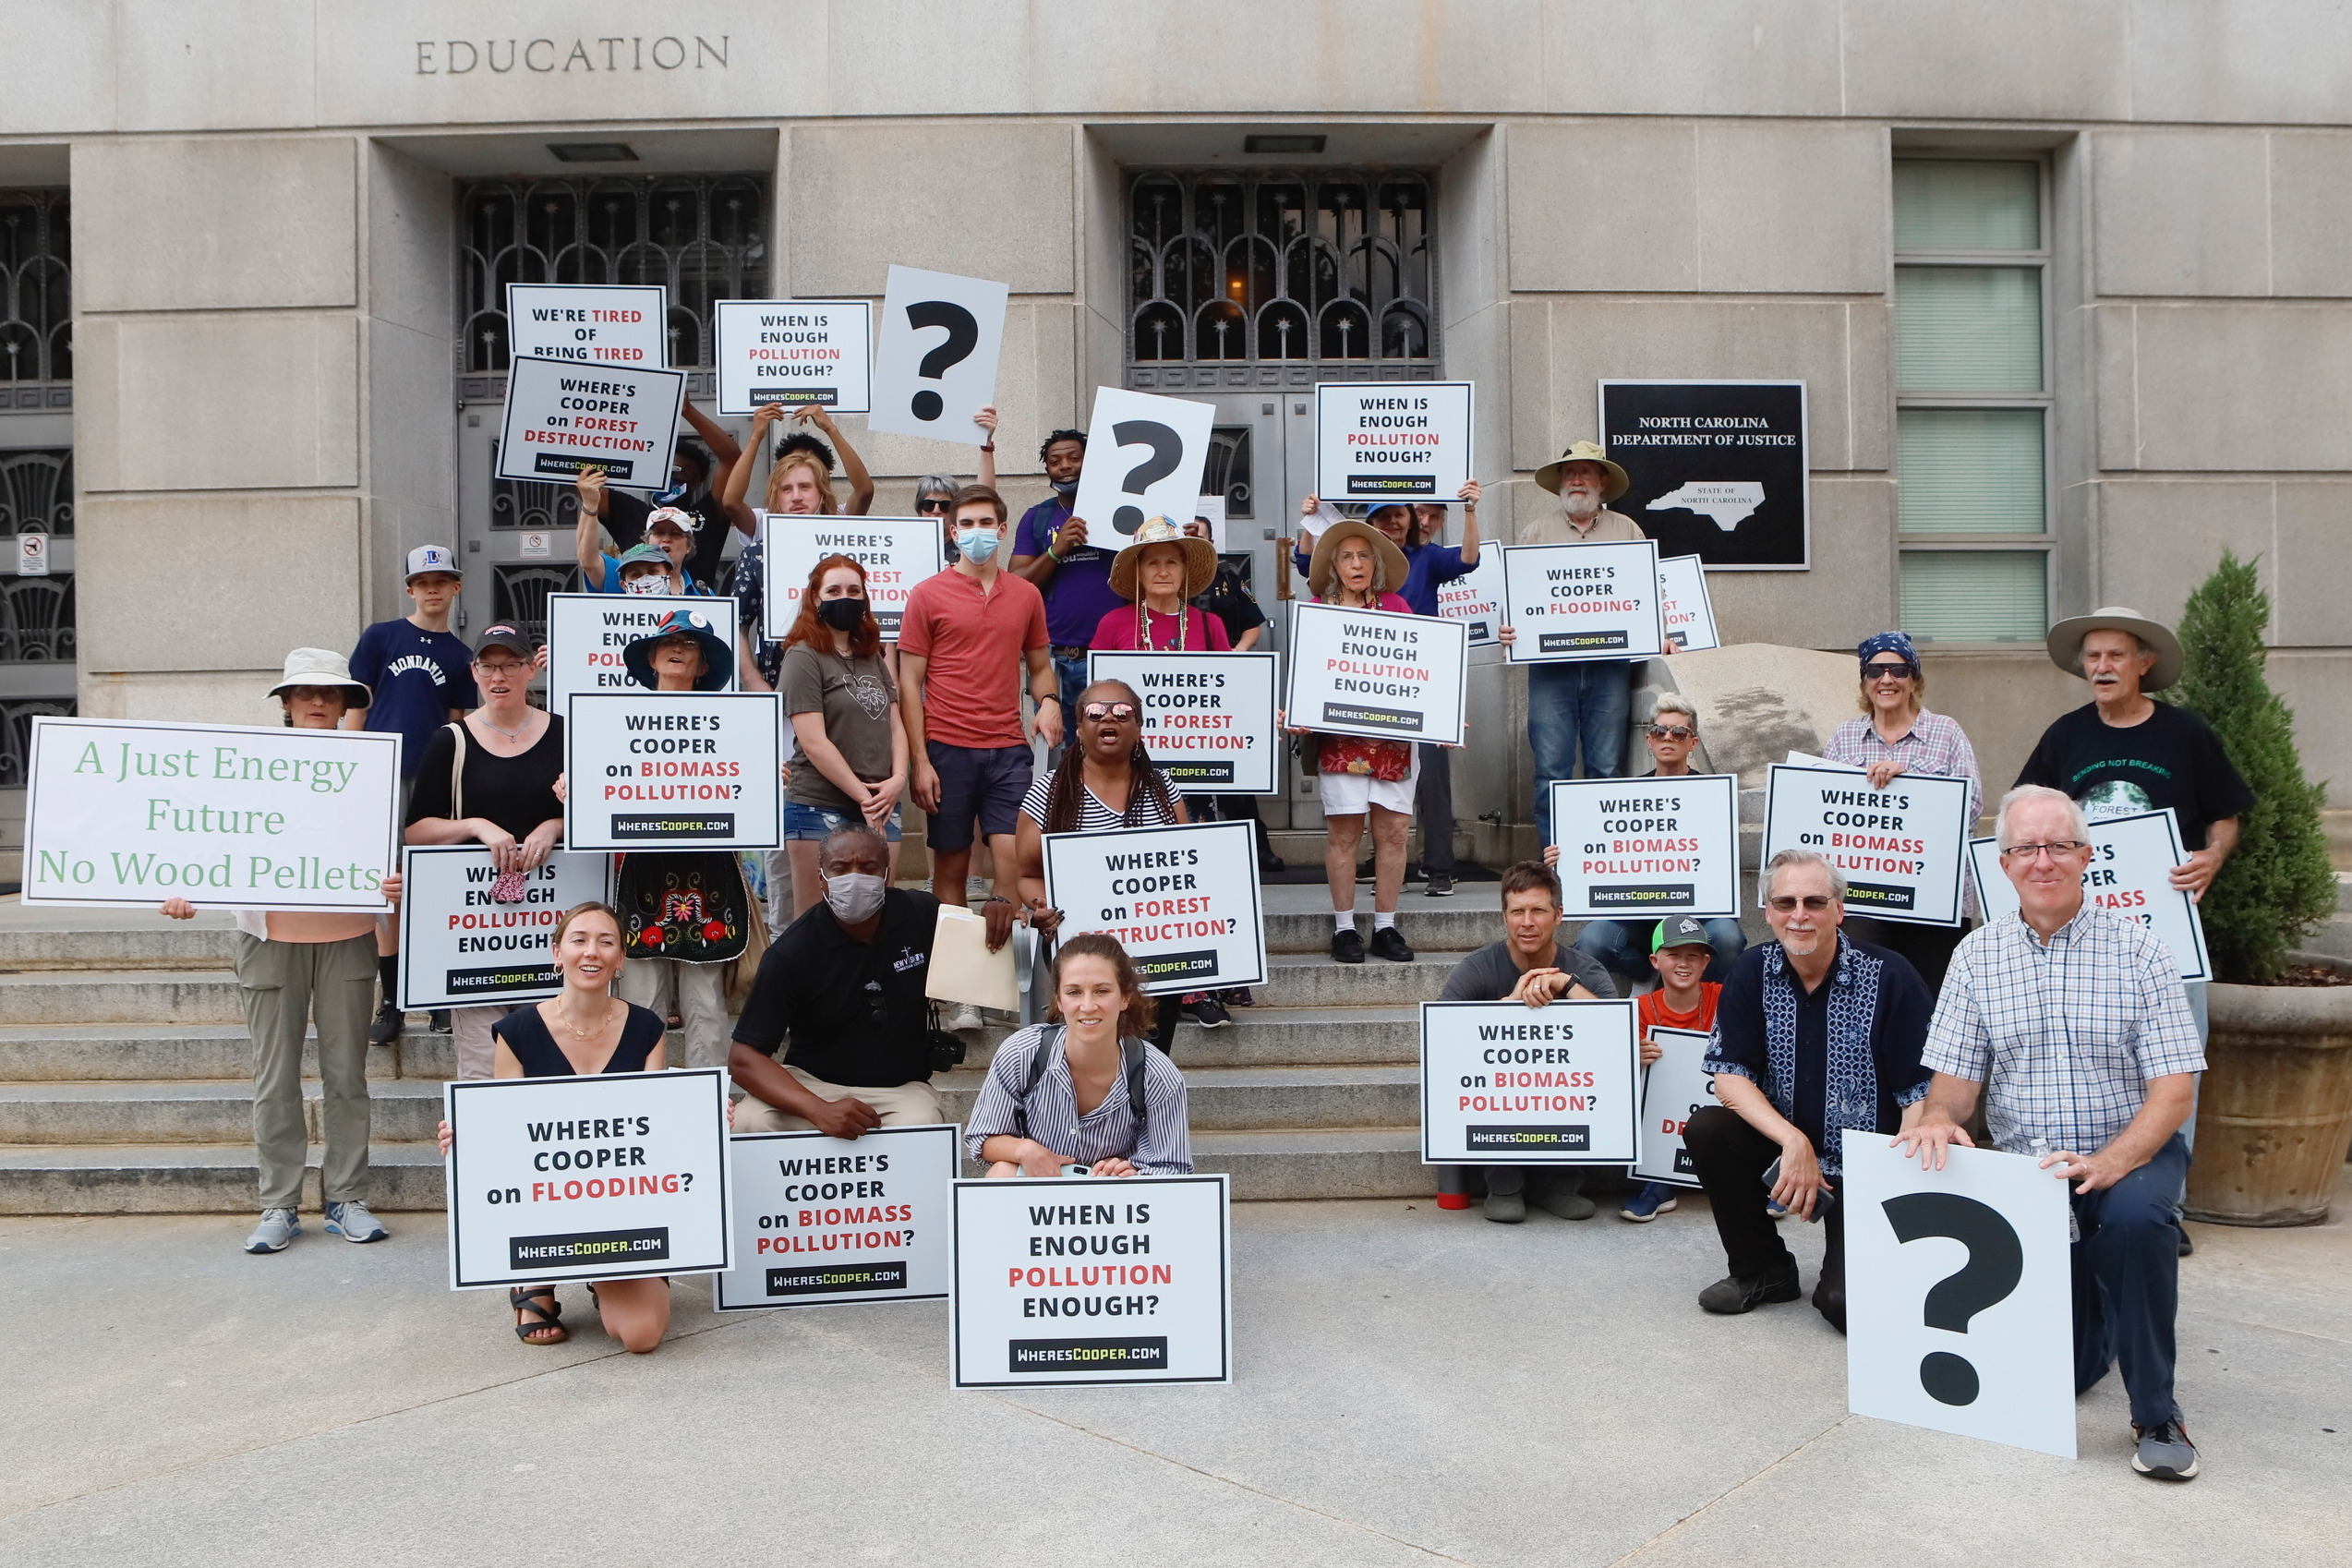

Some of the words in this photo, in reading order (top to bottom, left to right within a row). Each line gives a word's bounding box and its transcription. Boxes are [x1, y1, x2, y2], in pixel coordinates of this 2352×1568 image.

[416, 37, 730, 75] EDUCATION
[533, 309, 585, 321] WE'RE
[592, 310, 641, 322] TIRED
[761, 316, 808, 326] WHEN
[815, 316, 827, 326] IS
[575, 329, 596, 341] OF
[761, 332, 827, 343] ENOUGH
[594, 347, 643, 360] TIRED
[750, 349, 839, 359] POLLUTION
[905, 300, 979, 421] ?
[758, 366, 833, 376] ENOUGH?
[561, 379, 635, 397] WHERE'S
[561, 397, 629, 415] COOPER
[1360, 399, 1407, 409] WHEN
[1415, 398, 1428, 409] IS
[548, 416, 568, 427] on
[575, 416, 638, 433] FOREST
[1360, 416, 1427, 427] ENOUGH
[1639, 417, 1691, 428] NORTH
[1695, 417, 1769, 428] CAROLINA
[525, 430, 654, 452] DESTRUCTION?
[1348, 434, 1439, 445] POLLUTION
[1612, 434, 1712, 445] DEPARTMENT
[1715, 434, 1734, 445] OF
[1737, 434, 1796, 445] JUSTICE
[1356, 452, 1431, 463] ENOUGH?
[1112, 419, 1183, 536] ?
[815, 535, 893, 547] WHERE'S
[864, 571, 901, 583] REST
[1547, 567, 1614, 580] WHERE'S
[1437, 589, 1477, 603] OREST
[1551, 585, 1612, 597] COOPER
[1526, 607, 1544, 615] on
[1550, 599, 1640, 614] FLOODING?
[603, 613, 661, 626] WHEN
[1344, 624, 1395, 641] WHEN
[1404, 632, 1417, 643] IS
[1341, 643, 1417, 662] ENOUGH
[388, 655, 446, 687] MONDAMIN
[1327, 658, 1429, 682] POLLUTION
[1142, 674, 1224, 687] WHERE'S
[1334, 678, 1420, 699] ENOUGH?
[1146, 694, 1221, 707] COOPER
[626, 716, 719, 730] WHERE'S
[1146, 718, 1156, 728] n
[1164, 716, 1232, 729] FOREST
[630, 739, 716, 754] COOPER
[74, 742, 104, 774] A
[116, 743, 199, 782] Just
[213, 746, 358, 792] Energy
[606, 766, 632, 777] on
[642, 762, 739, 777] BIOMASS
[2072, 761, 2105, 782] BENDING
[2129, 759, 2172, 778] BREAKING
[605, 785, 742, 800] POLLUTION?
[1822, 790, 1909, 809] WHERE'S
[1599, 798, 1680, 813] WHERE'S
[2093, 805, 2138, 814] FOREST
[146, 799, 285, 835] Future
[1604, 818, 1677, 833] COOPER
[1824, 812, 1902, 830] COOPER
[1585, 843, 1605, 853] on
[1613, 838, 1698, 852] BIOMASS
[1800, 833, 1824, 845] on
[1832, 833, 1924, 854] BIOMASS
[1105, 850, 1198, 871] WHERE'S
[1584, 859, 1700, 874] POLLUTION?
[37, 850, 95, 885] No
[111, 851, 232, 887] Wood
[247, 856, 382, 891] Pellets
[538, 865, 556, 880] IS
[2081, 869, 2117, 887] PER
[1113, 874, 1197, 895] COOPER
[465, 888, 554, 905] ENGH
[1101, 907, 1127, 921] on
[1135, 897, 1210, 918] FOREST
[449, 911, 569, 930] POLLUTION
[459, 934, 553, 953] ENOUGH
[1478, 1025, 1573, 1040] WHERE'S
[1484, 1049, 1570, 1064] COOPER
[1461, 1076, 1486, 1088] on
[1495, 1072, 1594, 1087] BIOMASS
[1460, 1096, 1597, 1111] POLLUTION?
[527, 1116, 649, 1141] WHERE'S
[535, 1147, 646, 1171] COOPER
[779, 1155, 888, 1176] WHERE'S
[488, 1188, 520, 1204] on
[533, 1173, 693, 1201] FLOODING?
[785, 1181, 885, 1201] COOPER
[759, 1215, 788, 1228] on
[799, 1205, 911, 1226] BIOMASS
[1029, 1205, 1114, 1225] WHEN
[1127, 1204, 1150, 1224] IS
[758, 1230, 914, 1254] POLLUTION?
[1031, 1235, 1149, 1256] ENOUGH
[1009, 1265, 1171, 1287] POLLUTION
[1024, 1296, 1159, 1317] ENOUGH?
[1881, 1192, 2023, 1406] ?
